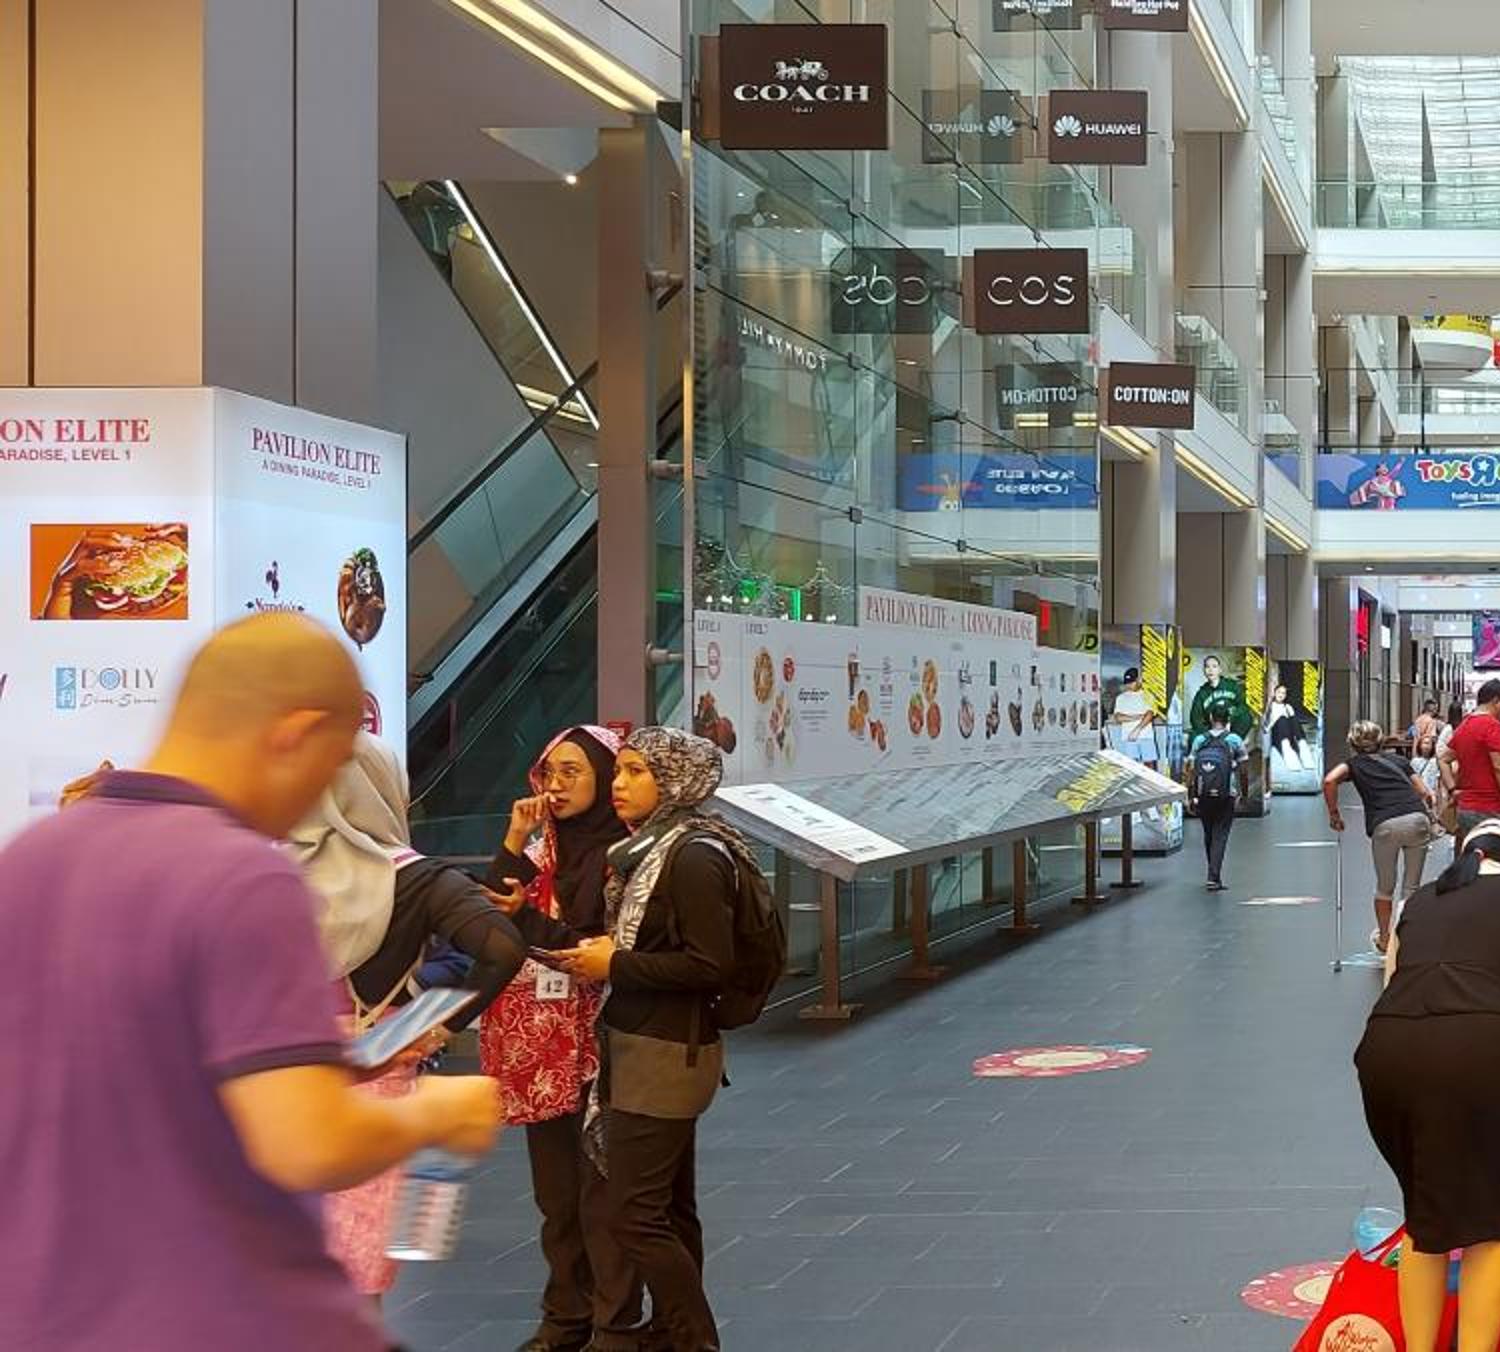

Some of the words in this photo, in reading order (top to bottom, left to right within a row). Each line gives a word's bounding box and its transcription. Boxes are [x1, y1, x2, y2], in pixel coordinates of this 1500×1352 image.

[733, 84, 869, 101] COACH
[1085, 123, 1141, 135] HUAWEI
[987, 275, 1076, 306] COS
[1114, 386, 1190, 405] COTTON:ON
[55, 419, 151, 443] ELITE
[72, 450, 119, 461] LEVEL
[252, 427, 329, 464] PAVILION
[335, 446, 380, 475] ELITE
